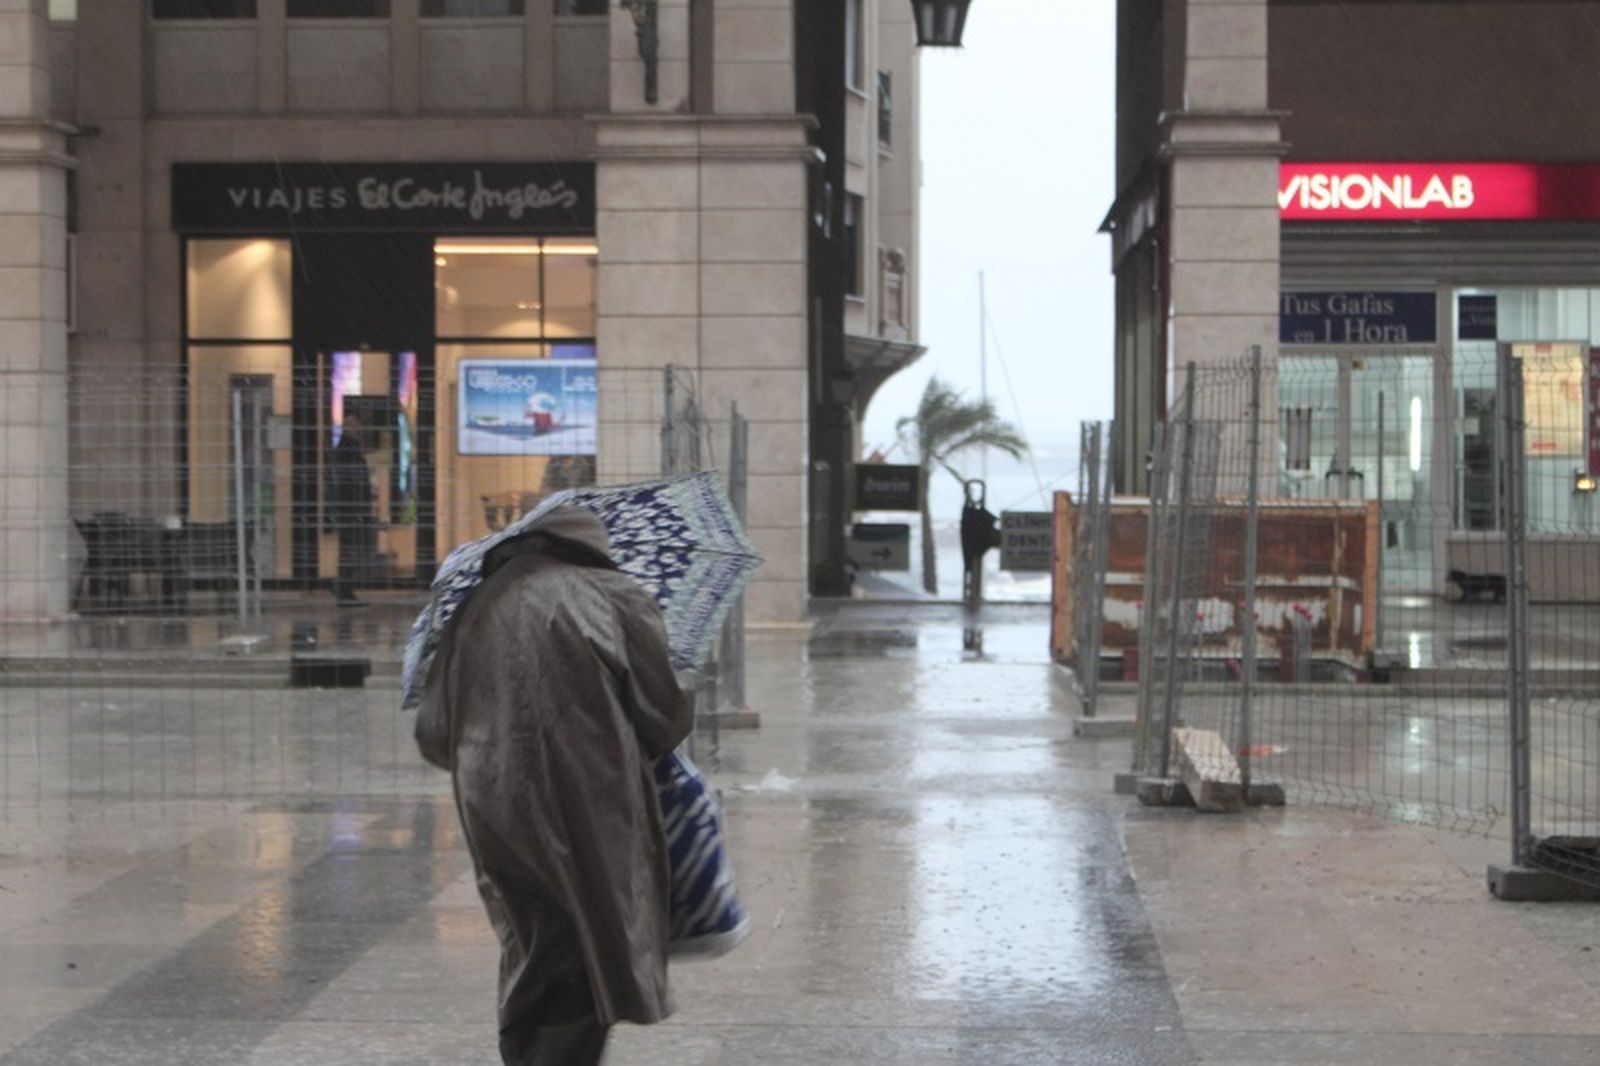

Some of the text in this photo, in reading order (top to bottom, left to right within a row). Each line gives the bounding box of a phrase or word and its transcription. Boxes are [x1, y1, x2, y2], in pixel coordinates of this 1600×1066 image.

[228, 187, 347, 211] VIAJES
[357, 177, 390, 210] El
[392, 177, 466, 210] Corte
[1279, 174, 1475, 210] VISIONLAB
[1282, 294, 1395, 316] Tus Gafas
[1323, 318, 1333, 342] 1
[1344, 318, 1409, 342] Hora
